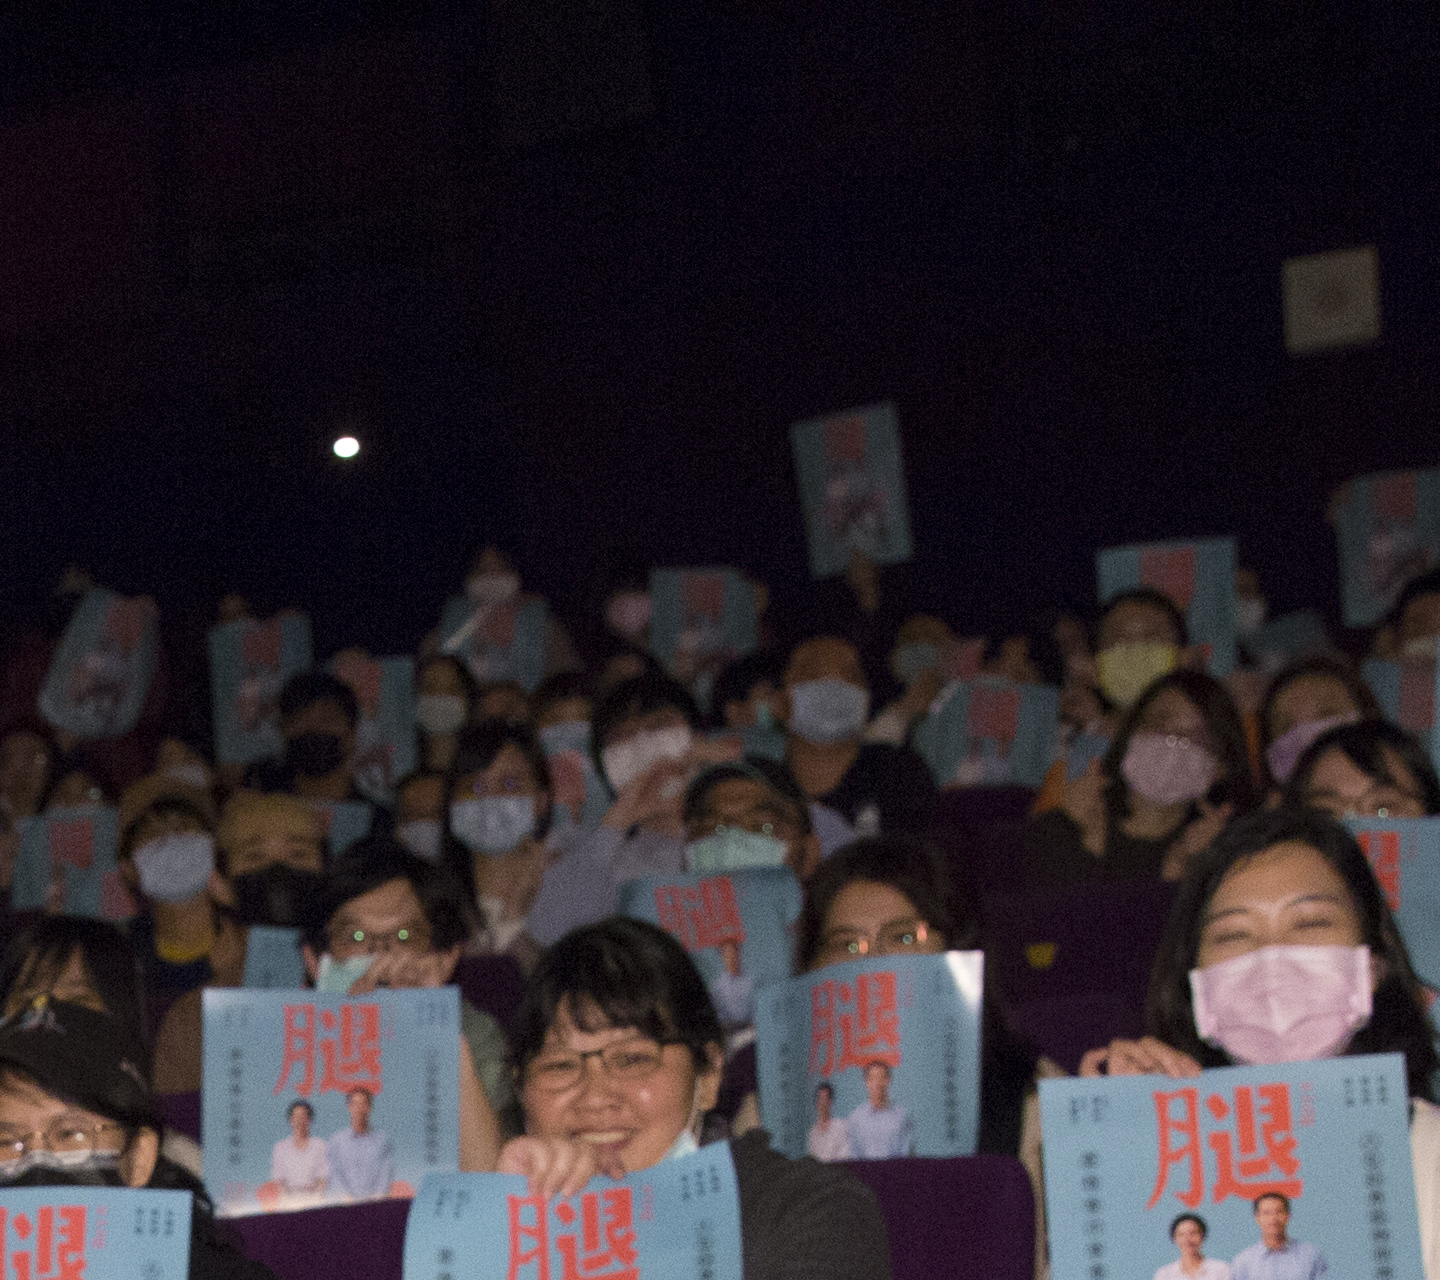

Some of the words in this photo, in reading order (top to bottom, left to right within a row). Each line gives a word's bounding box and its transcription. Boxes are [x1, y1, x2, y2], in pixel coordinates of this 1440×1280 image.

[272, 1003, 383, 1098] 腿
[809, 971, 903, 1077] 腿
[1145, 1083, 1304, 1211] 腿
